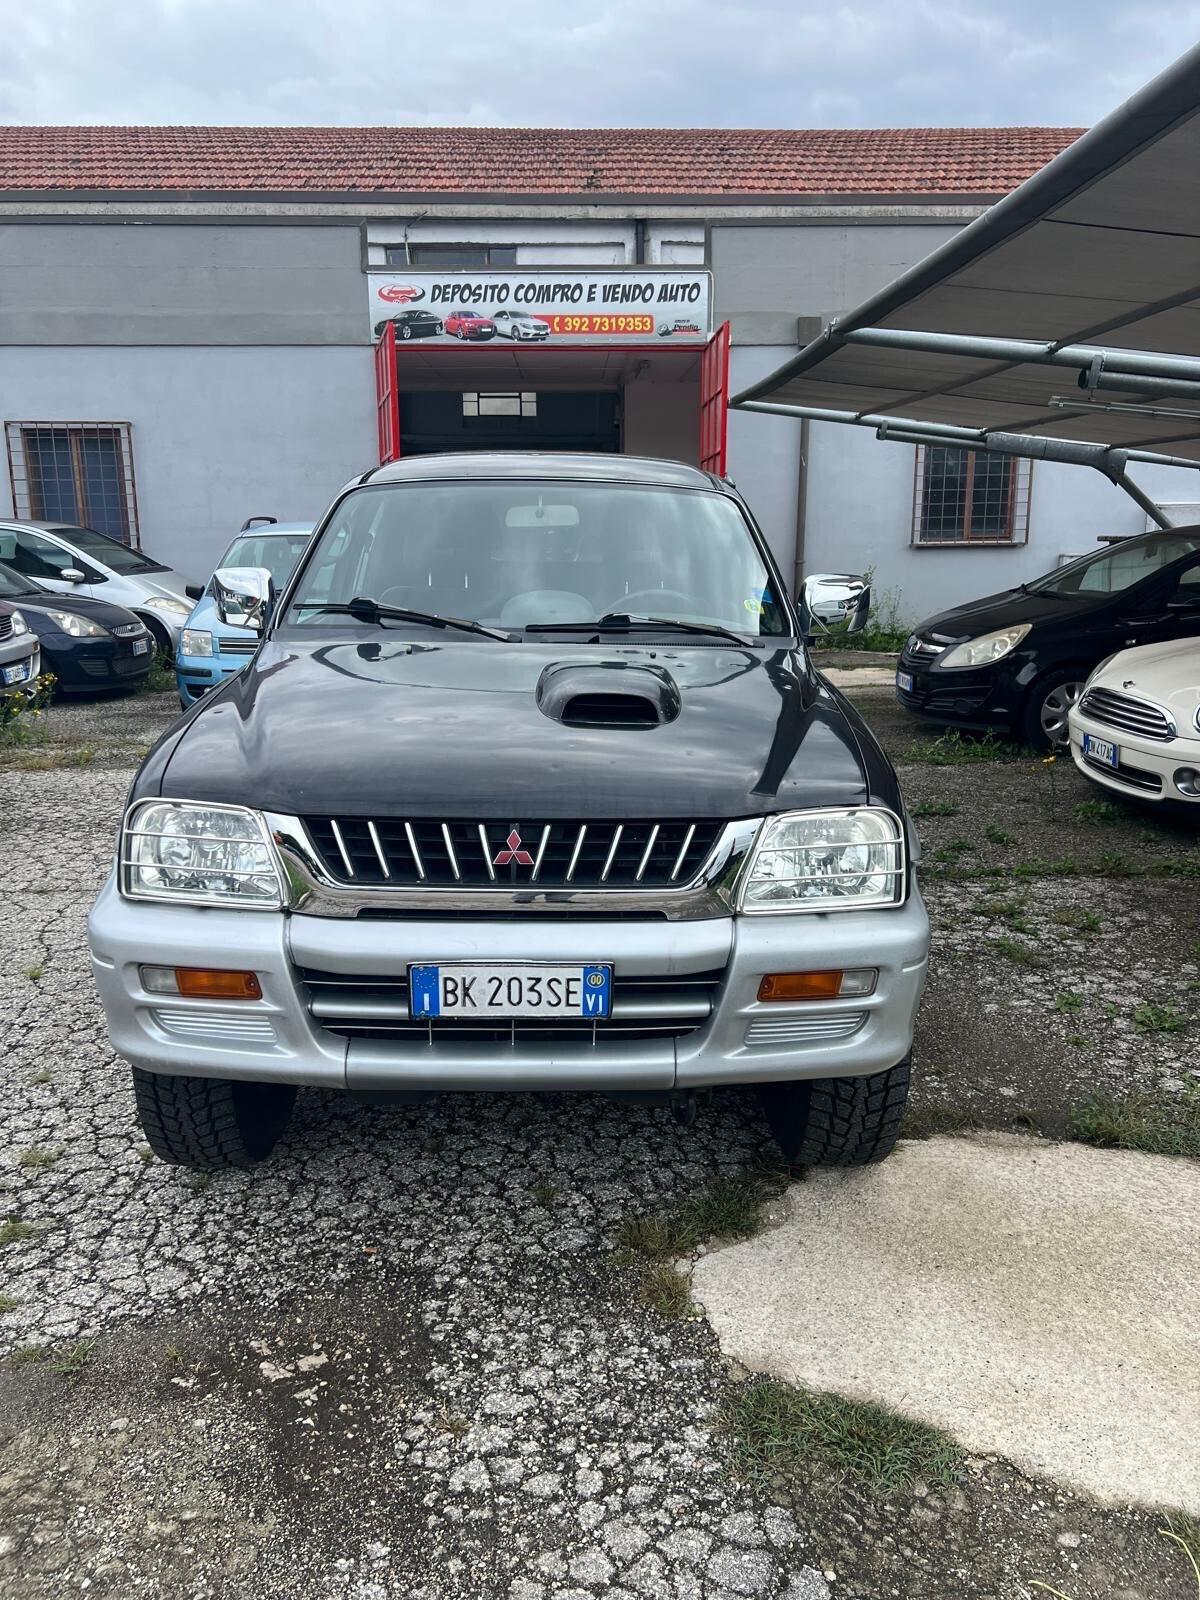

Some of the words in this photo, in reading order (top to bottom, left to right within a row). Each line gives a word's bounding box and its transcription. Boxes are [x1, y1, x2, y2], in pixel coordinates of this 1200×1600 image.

[430, 284, 509, 304] DEPOSITO
[514, 283, 583, 304] COMPRO
[587, 284, 597, 303] E
[602, 283, 655, 304] VENDO
[657, 282, 701, 304] AUTO
[564, 317, 590, 332] 392
[593, 316, 651, 332] 7319353
[442, 976, 478, 1007] BK
[487, 976, 582, 1007] 203SE
[586, 993, 604, 1012] VI
